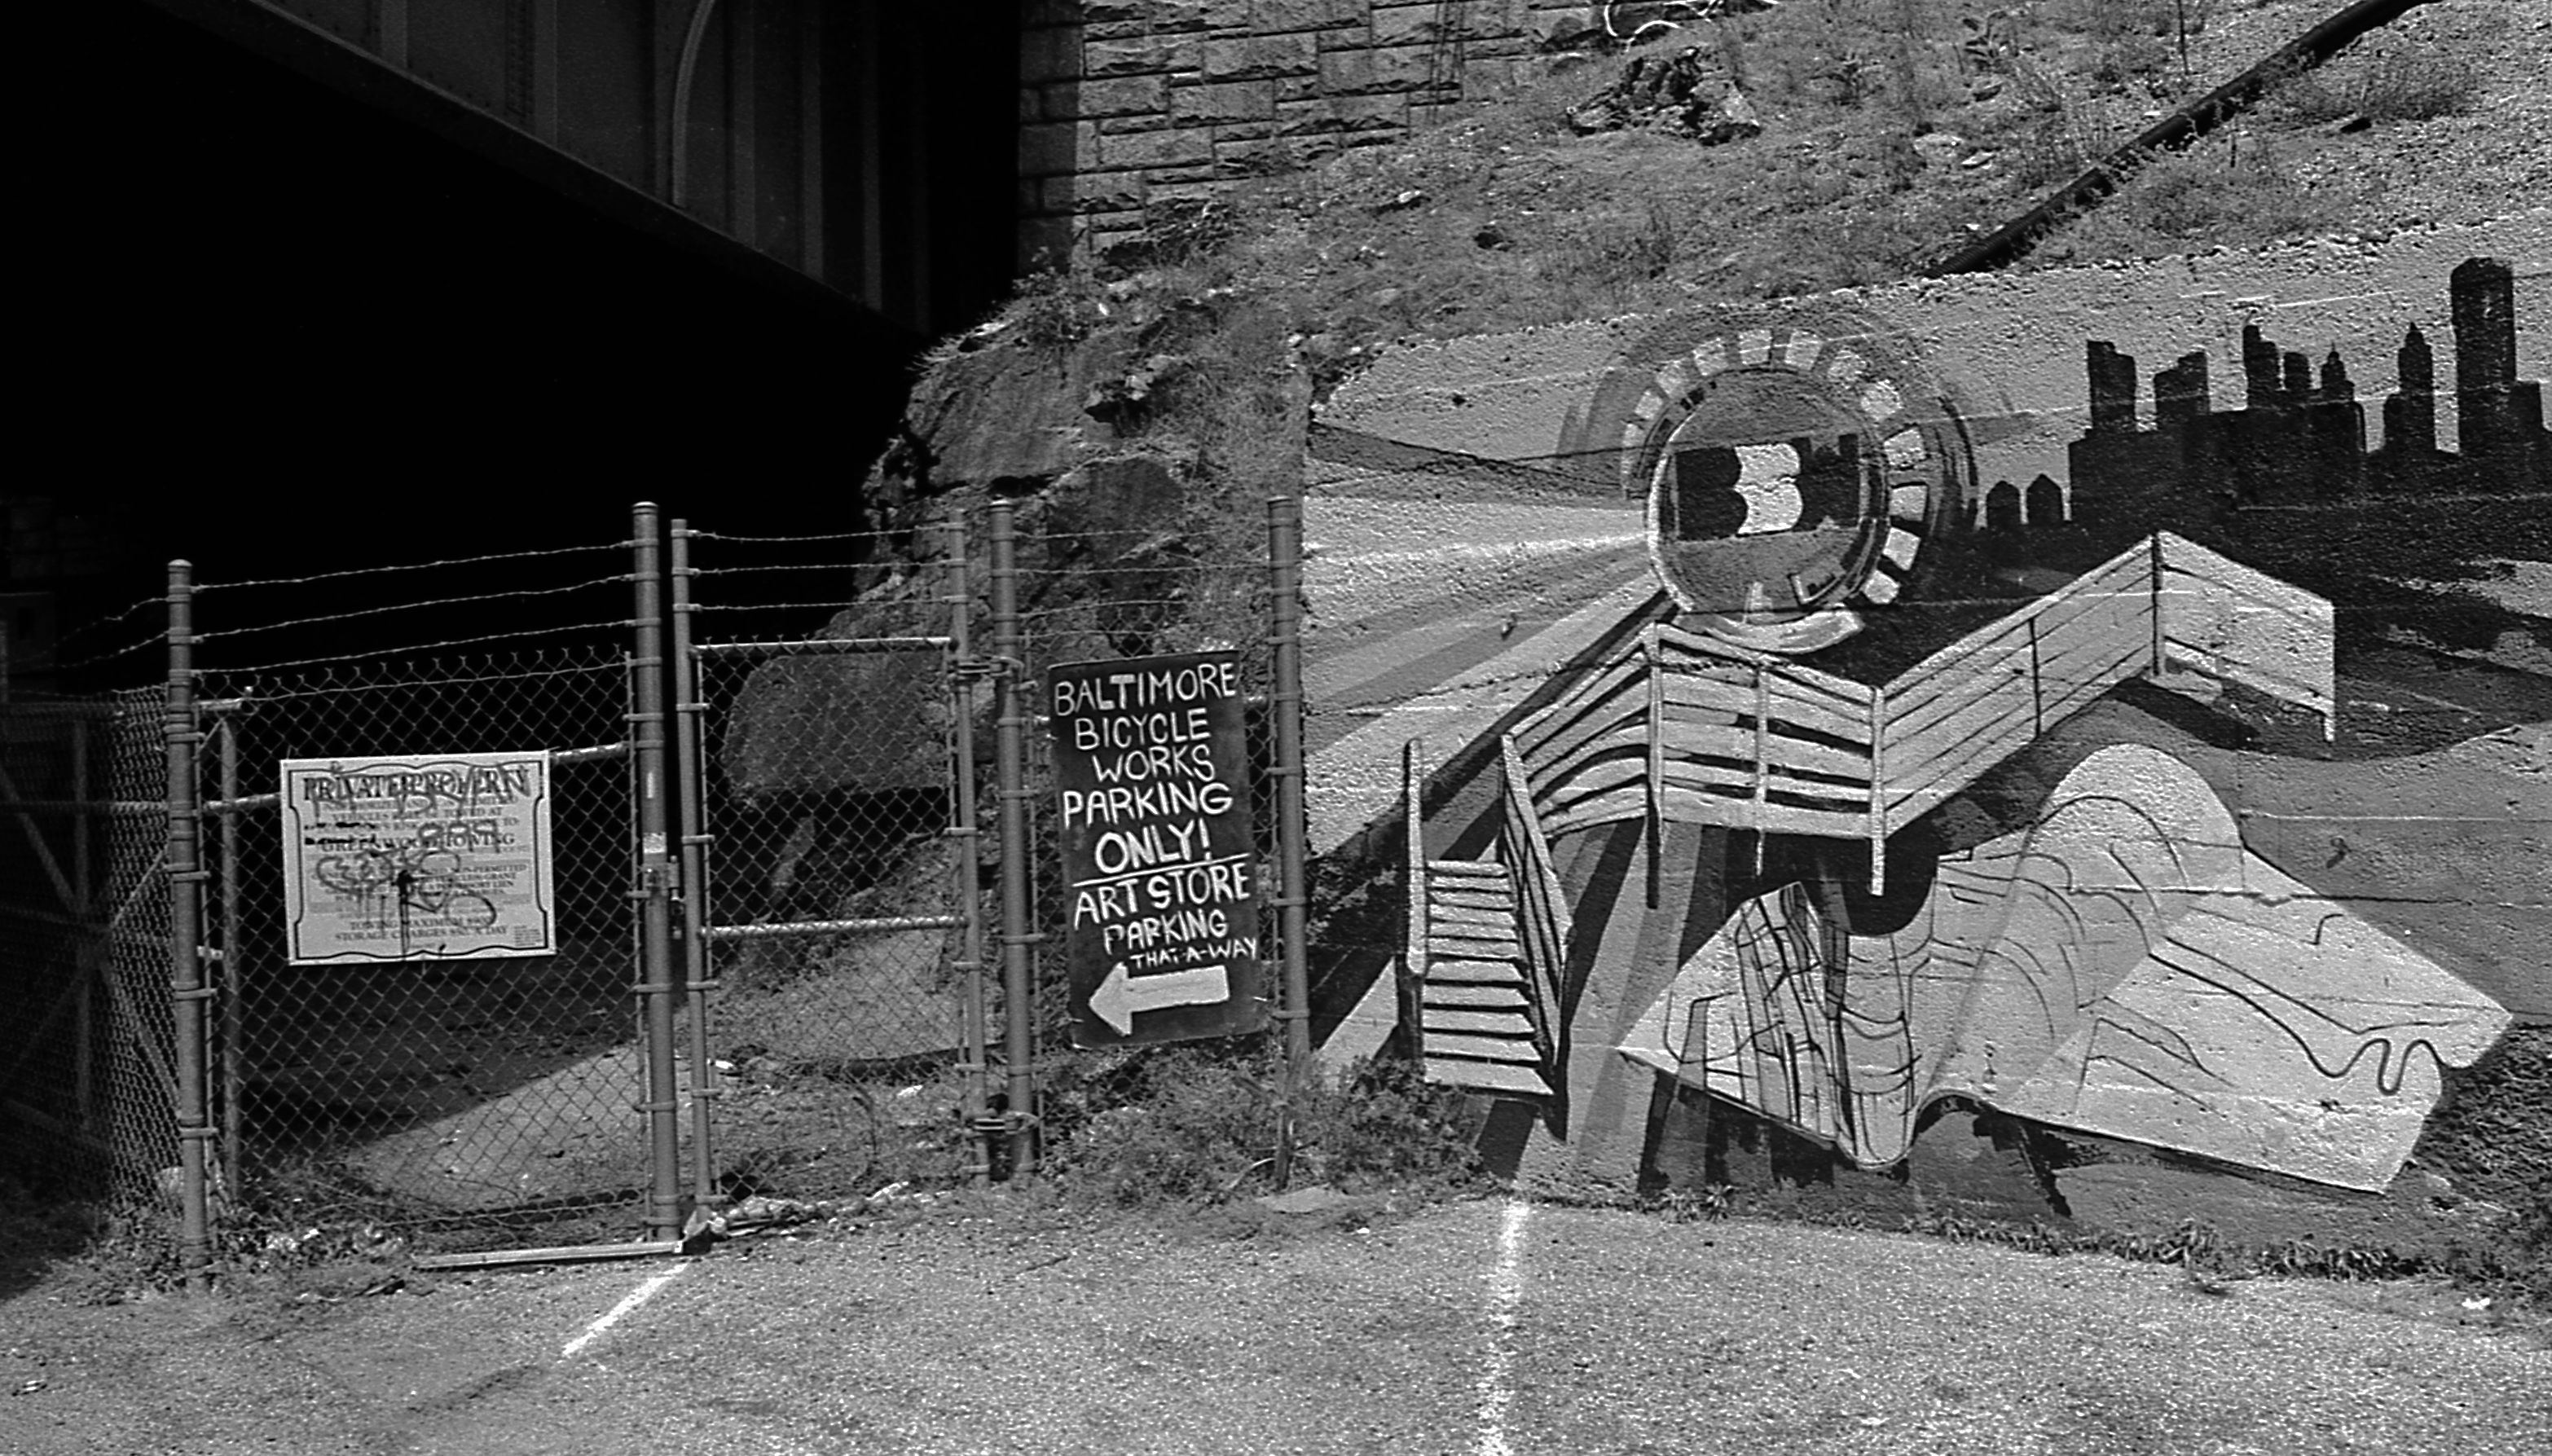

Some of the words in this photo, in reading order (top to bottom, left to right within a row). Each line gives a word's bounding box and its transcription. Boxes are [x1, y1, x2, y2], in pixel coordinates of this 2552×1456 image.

[1054, 663, 1237, 716] BALTIMORE
[1075, 707, 1212, 750] BICYCLE
[1092, 744, 1216, 782] WORKS
[304, 775, 398, 800] PRIVATE
[1063, 780, 1233, 829] PARKING
[1095, 818, 1212, 873] ONLY!
[1073, 878, 1139, 930] ART
[1147, 862, 1251, 909] STORE
[391, 927, 447, 939] CARGES
[1103, 908, 1228, 956] PARKING
